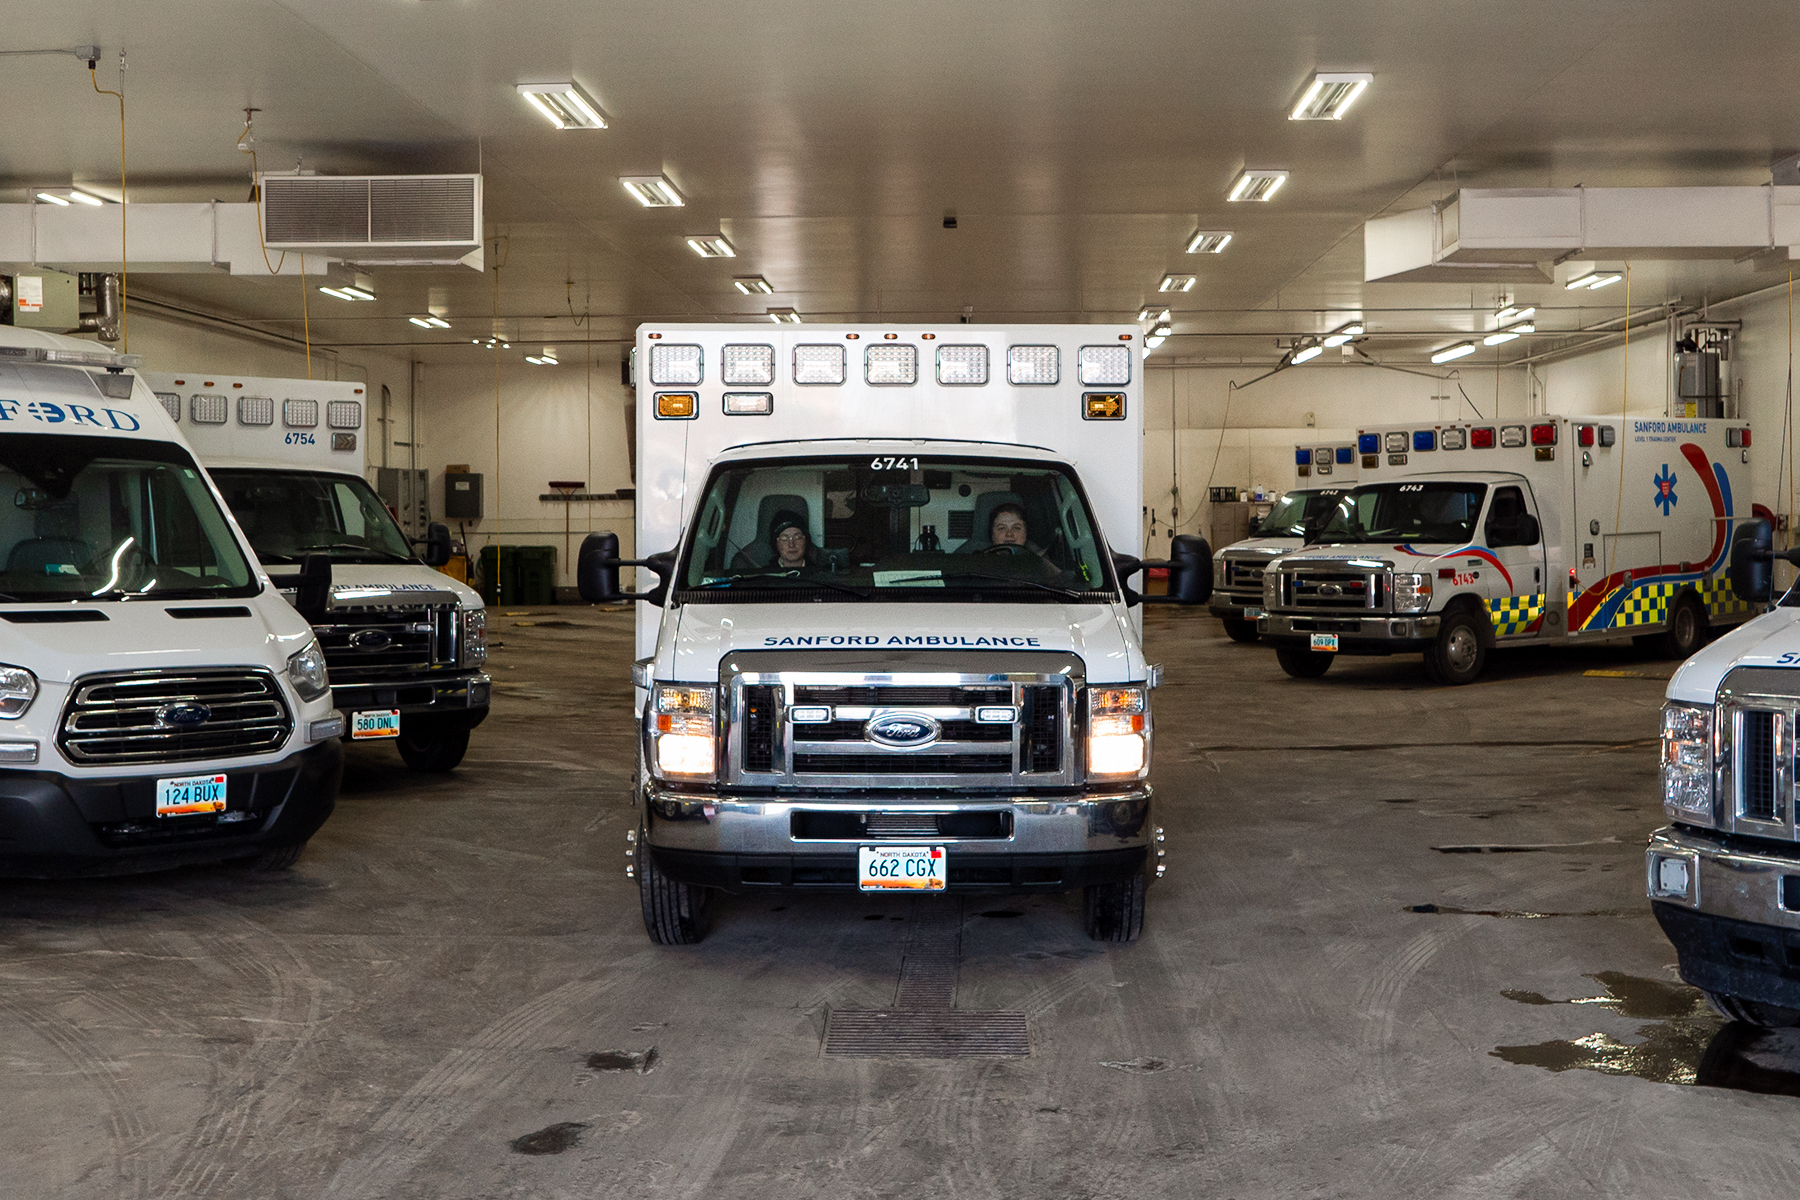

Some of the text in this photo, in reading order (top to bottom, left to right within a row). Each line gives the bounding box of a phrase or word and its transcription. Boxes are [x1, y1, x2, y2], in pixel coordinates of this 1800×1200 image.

[1634, 421, 1706, 433] SANFORD AMBULANCE
[284, 432, 315, 445] 6754
[870, 457, 919, 470] 6741
[1399, 484, 1424, 492] 6743
[1452, 572, 1474, 586] 6743
[763, 635, 1041, 647] SANFORD AMBULANCE
[174, 707, 201, 721] Ford
[357, 717, 394, 731] 580 DNL
[886, 723, 921, 738] Ford
[166, 784, 219, 805] 124 BUX
[868, 858, 936, 878] 662 CGX
